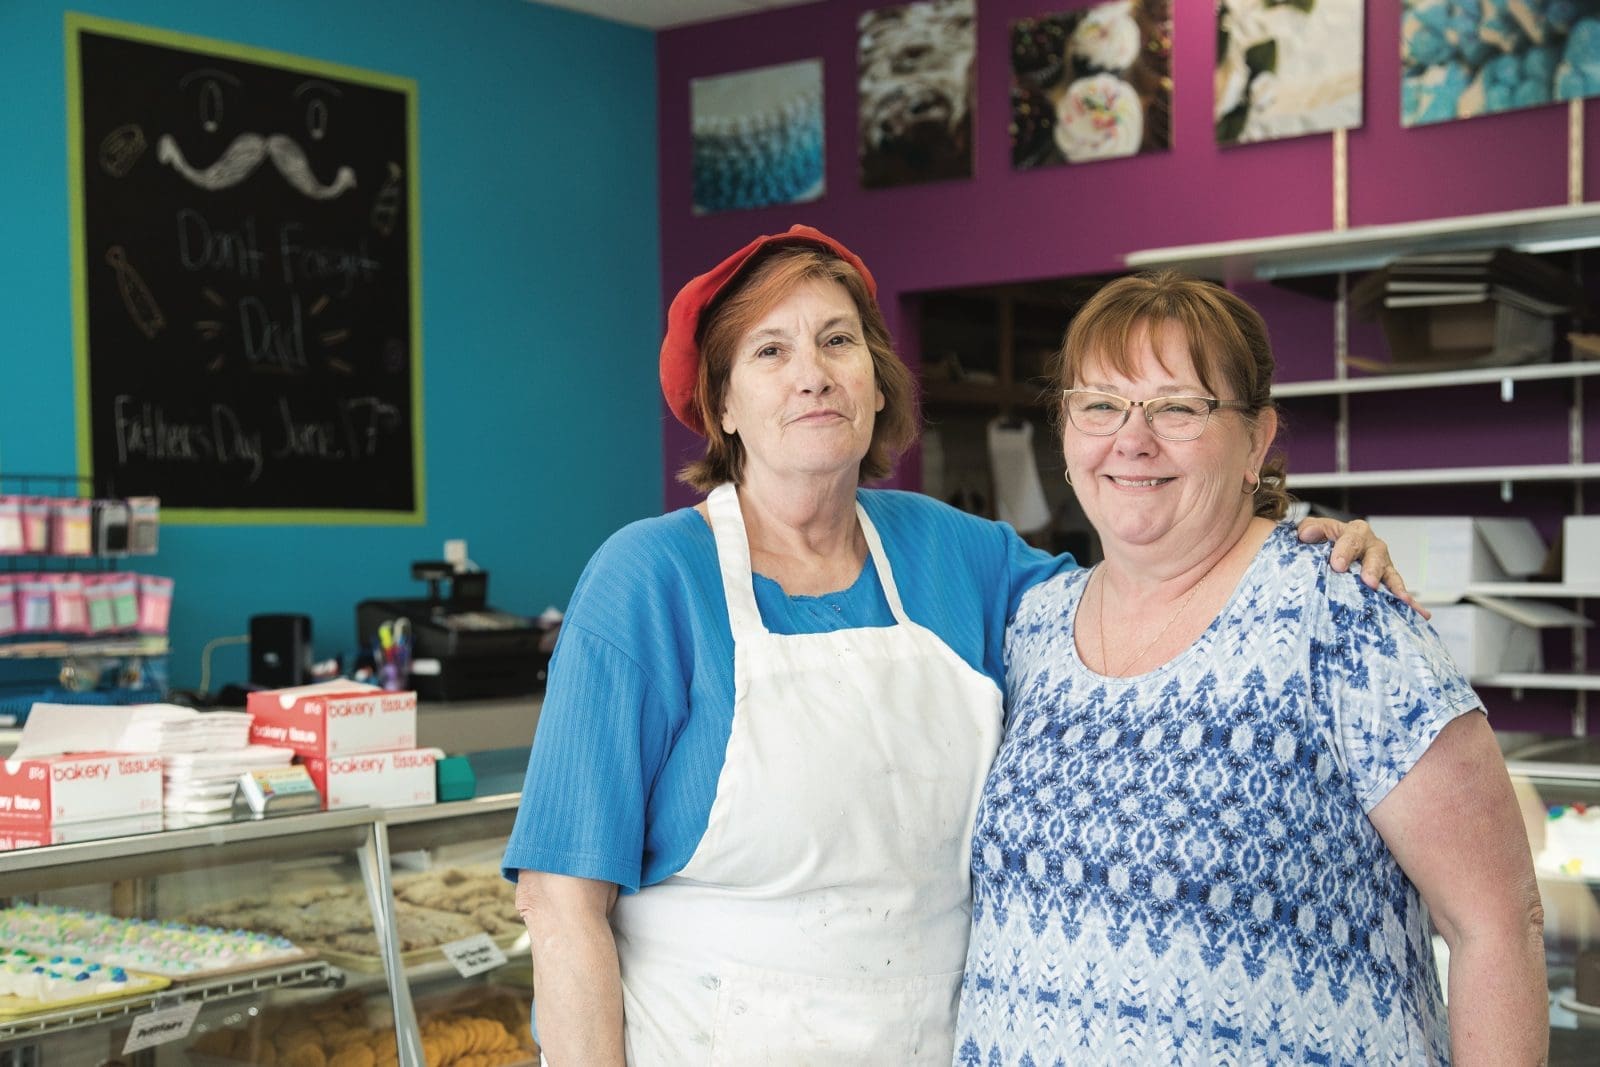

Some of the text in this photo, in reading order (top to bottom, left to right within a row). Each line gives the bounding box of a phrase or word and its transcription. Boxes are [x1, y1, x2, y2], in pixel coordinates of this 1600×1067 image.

[237, 292, 308, 369] Dad
[213, 403, 264, 483] Day
[329, 701, 375, 718] bakery
[289, 727, 317, 743] tissue
[54, 763, 111, 782] bakery
[329, 758, 386, 775] bakery
